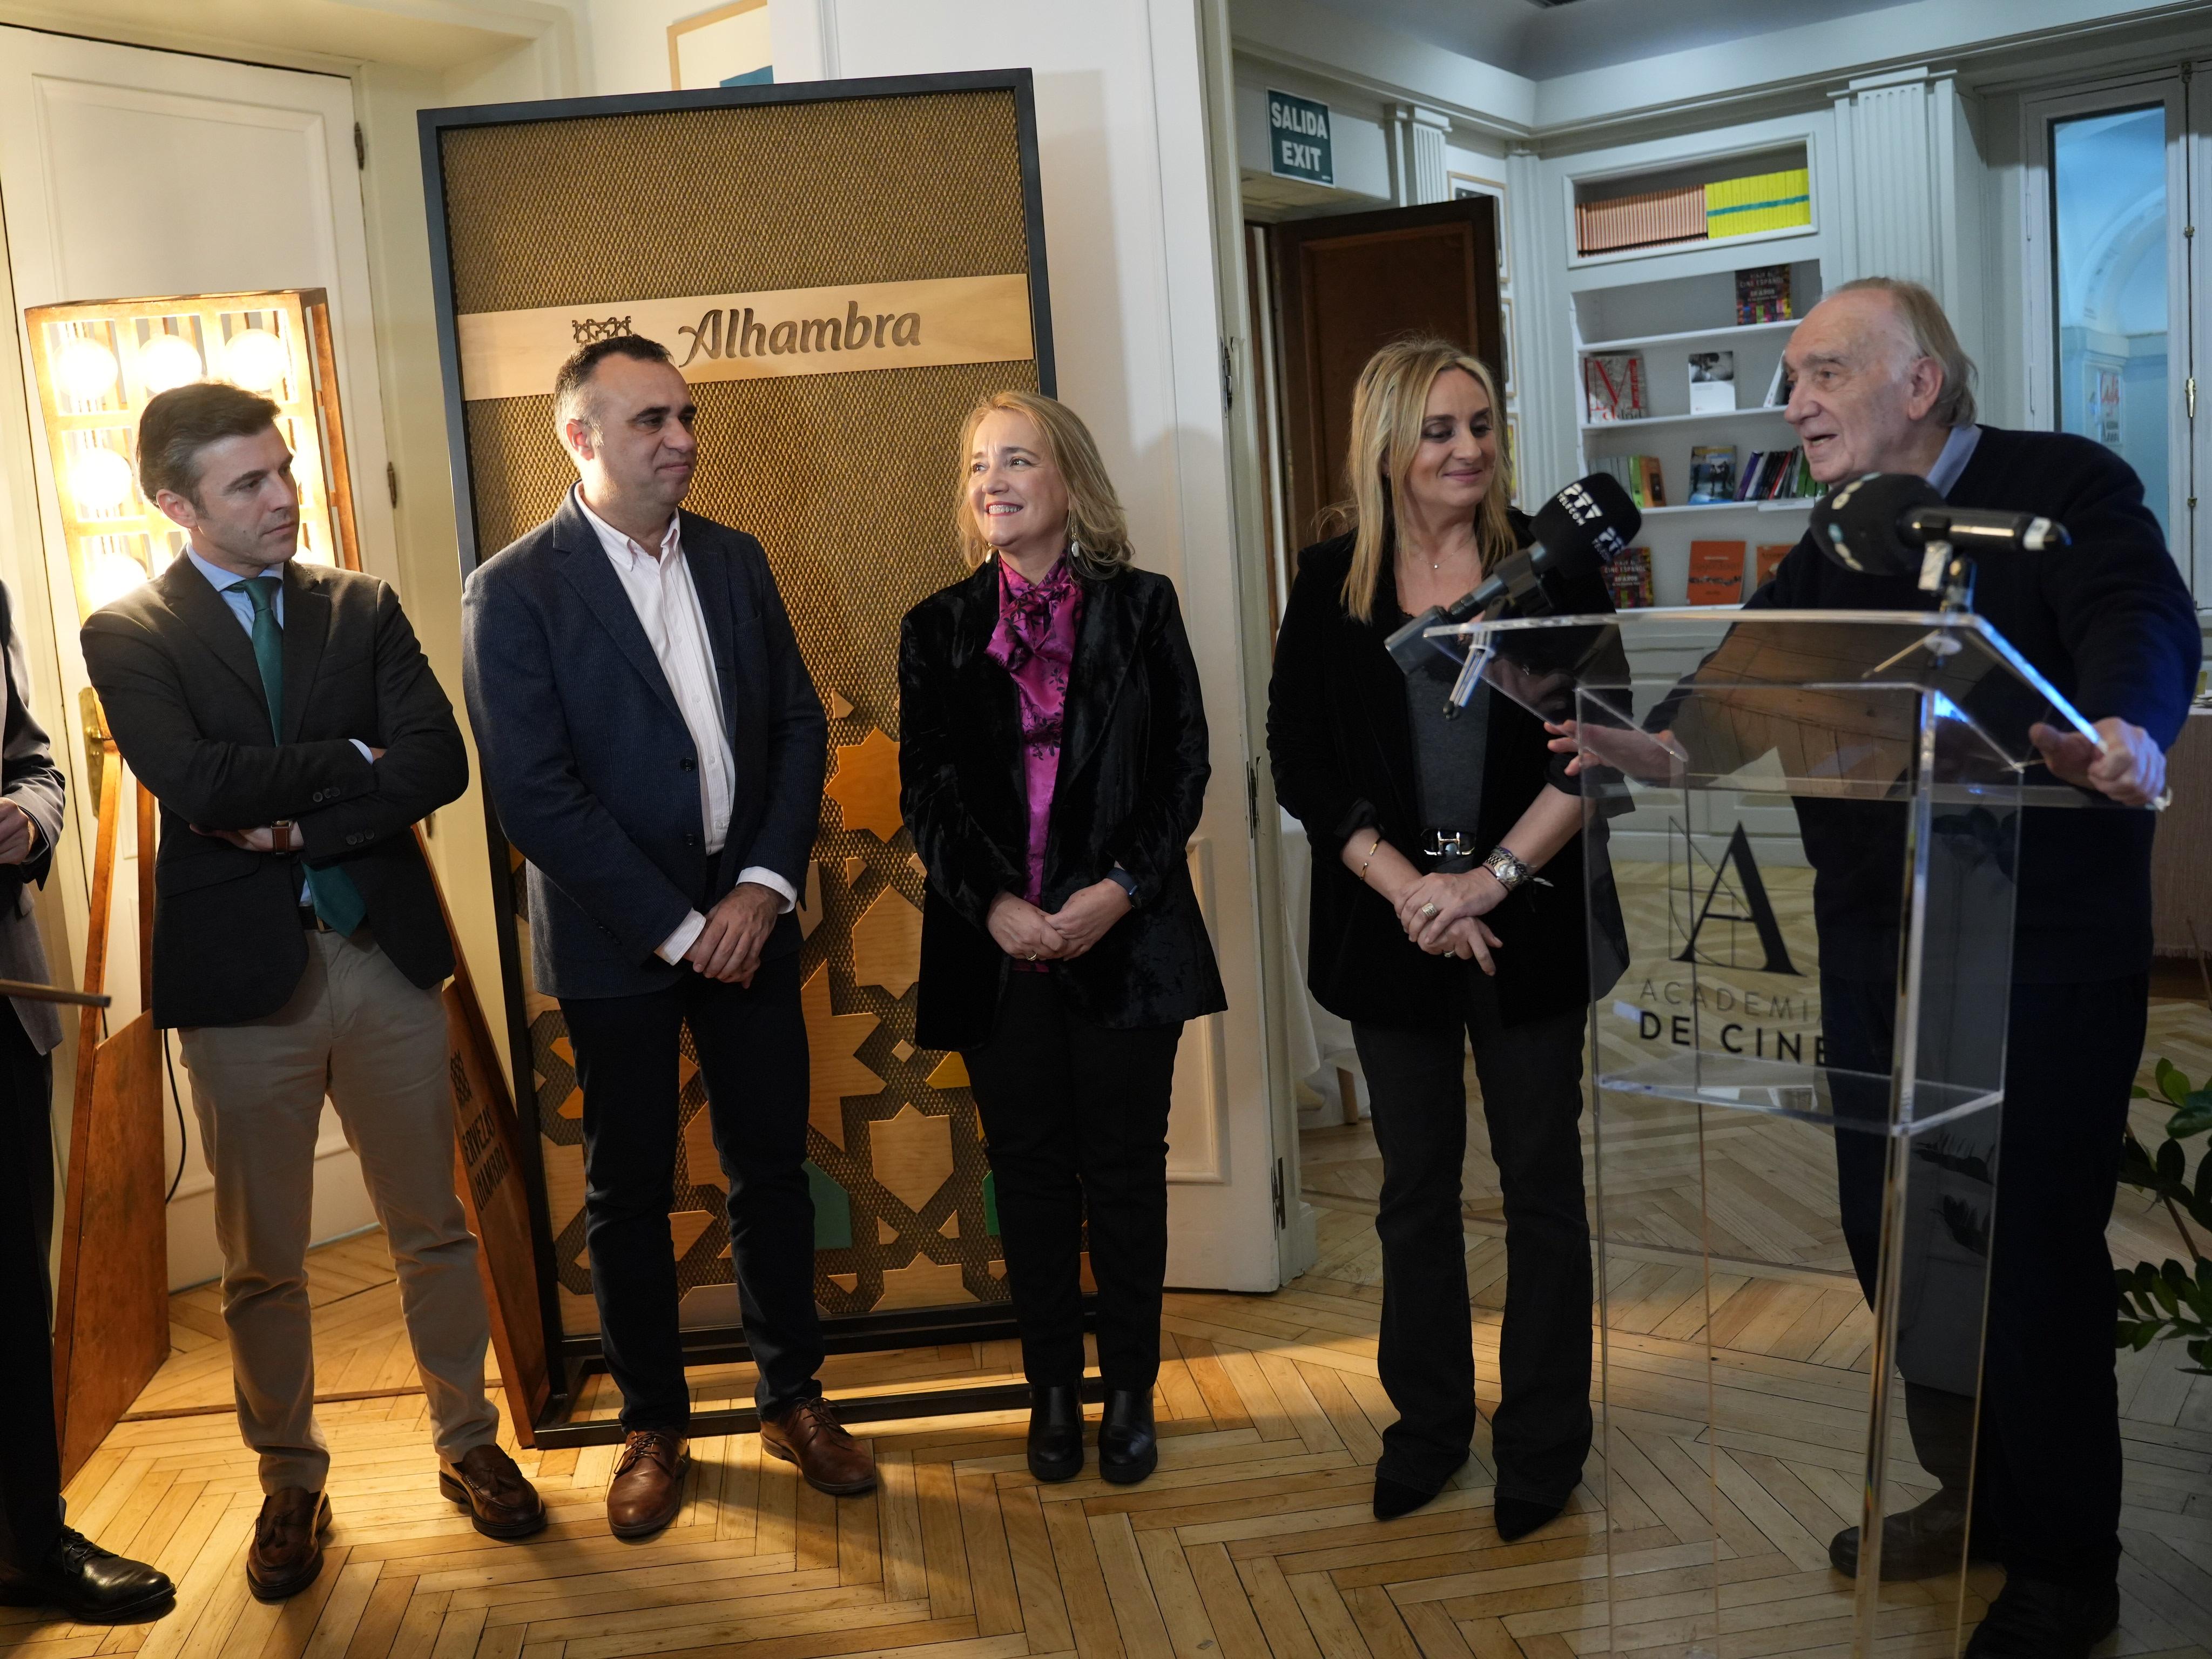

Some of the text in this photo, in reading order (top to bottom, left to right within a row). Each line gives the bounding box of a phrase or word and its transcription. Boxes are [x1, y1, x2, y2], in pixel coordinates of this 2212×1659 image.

[1271, 102, 1328, 139] SALIDA
[1282, 140, 1322, 172] EXIT
[678, 300, 921, 368] Alhambra
[1556, 492, 1586, 527] TELECOM
[1640, 1010, 1829, 1066] DE CINE
[462, 1104, 495, 1168] ERVEZAS
[474, 1142, 510, 1211] LHAMBRA
